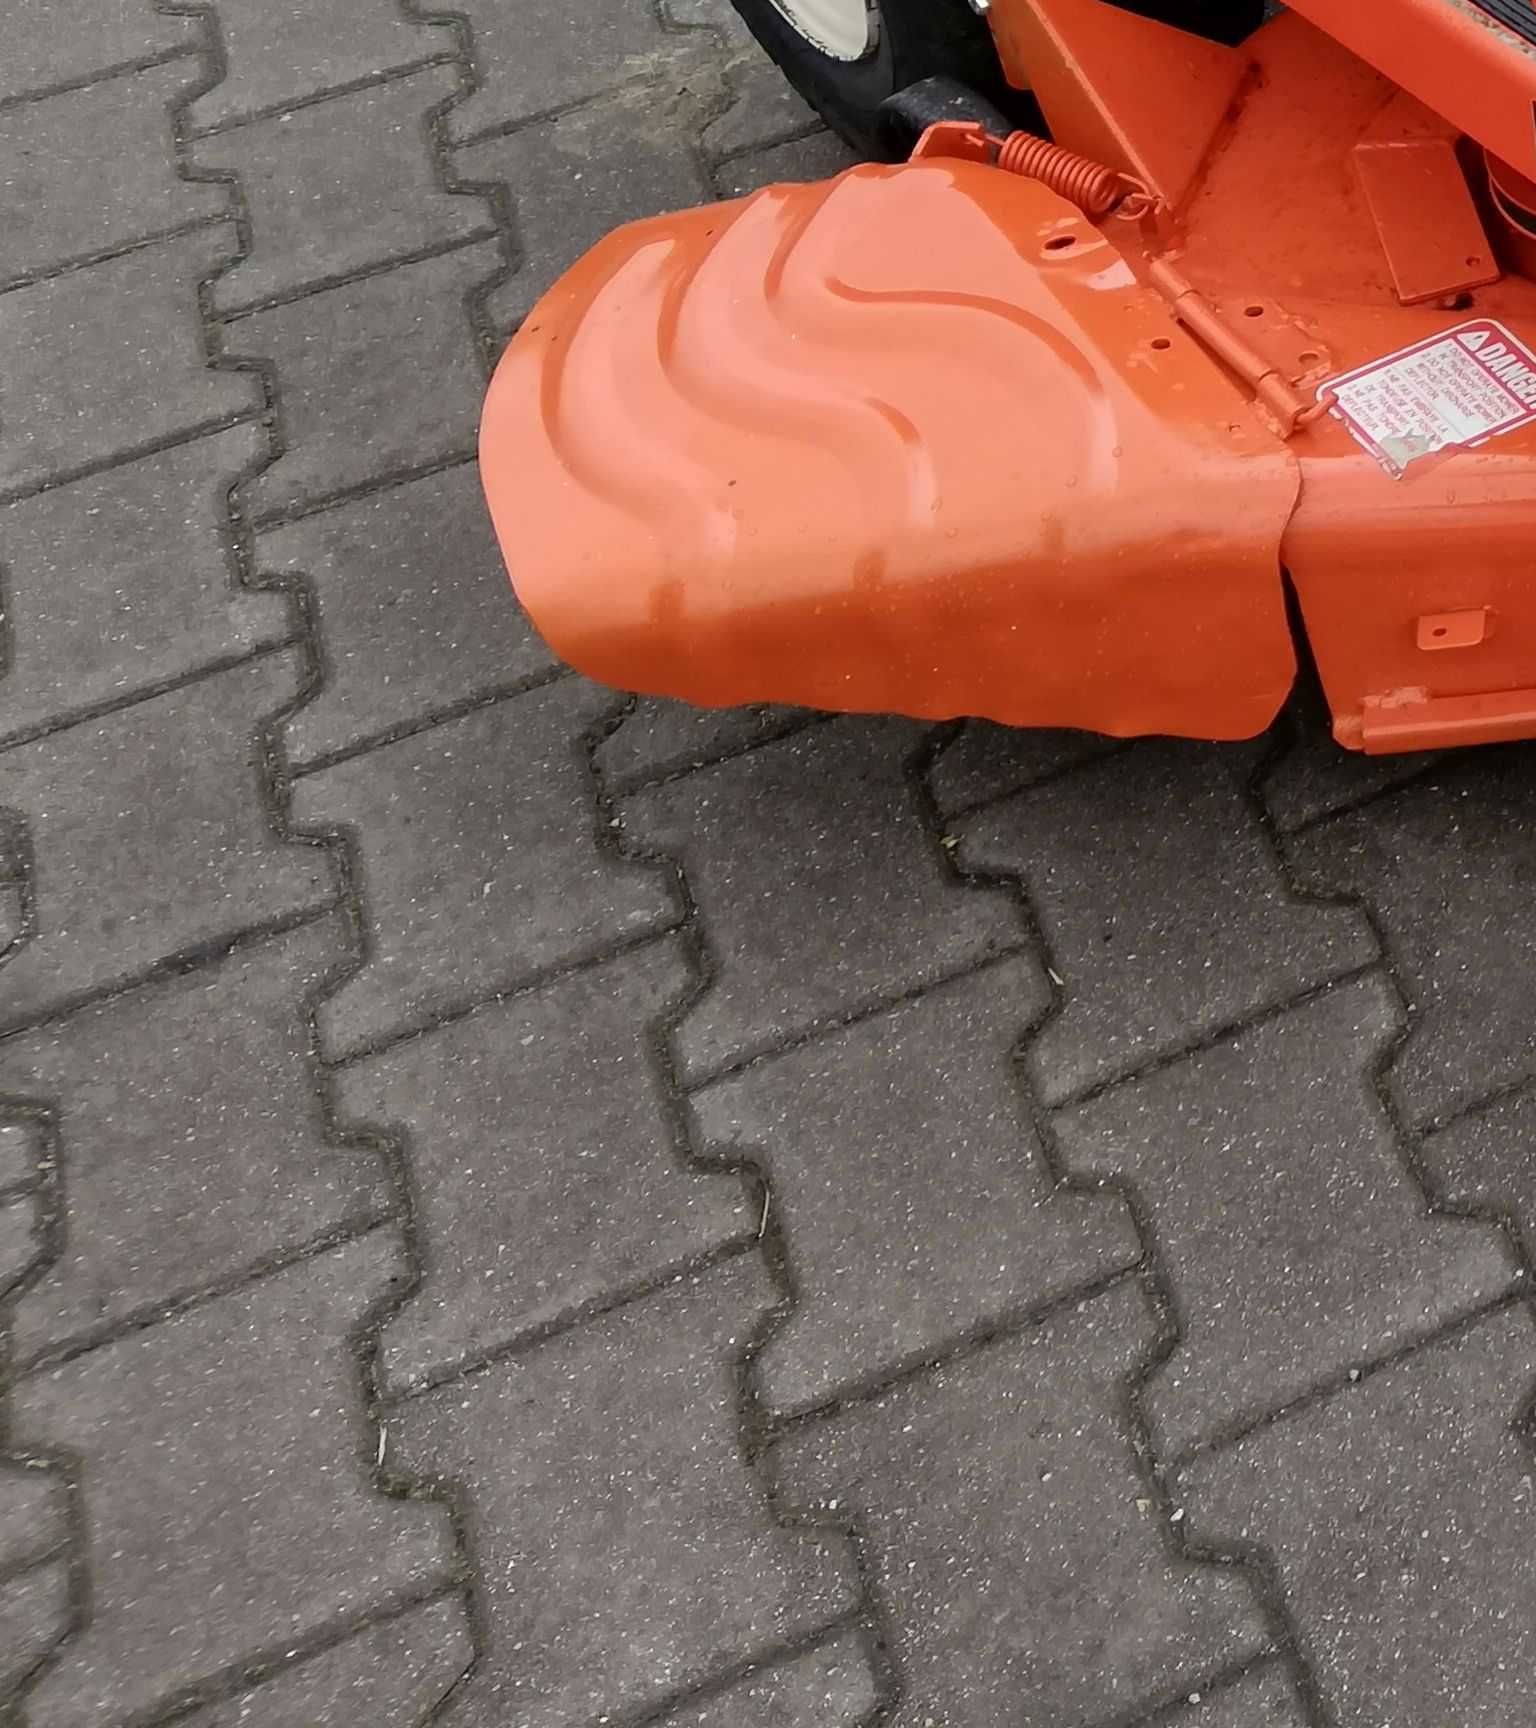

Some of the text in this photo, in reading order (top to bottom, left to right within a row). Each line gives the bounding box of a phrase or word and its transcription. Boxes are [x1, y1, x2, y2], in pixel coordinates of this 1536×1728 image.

[1418, 363, 1441, 384] WITHOUT
[1450, 361, 1480, 389] TRANSPORT
[1450, 348, 1461, 356] DO
[1460, 357, 1473, 366] NOT
[1472, 370, 1499, 392] OPERATE
[1497, 394, 1518, 413] MOWER
[1399, 384, 1411, 395] PAS
[1428, 358, 1439, 366] DO
[1438, 367, 1451, 378] NOT
[1449, 379, 1476, 403] OPERATE
[1474, 404, 1495, 423] MOWER
[1364, 400, 1377, 411] PAS
